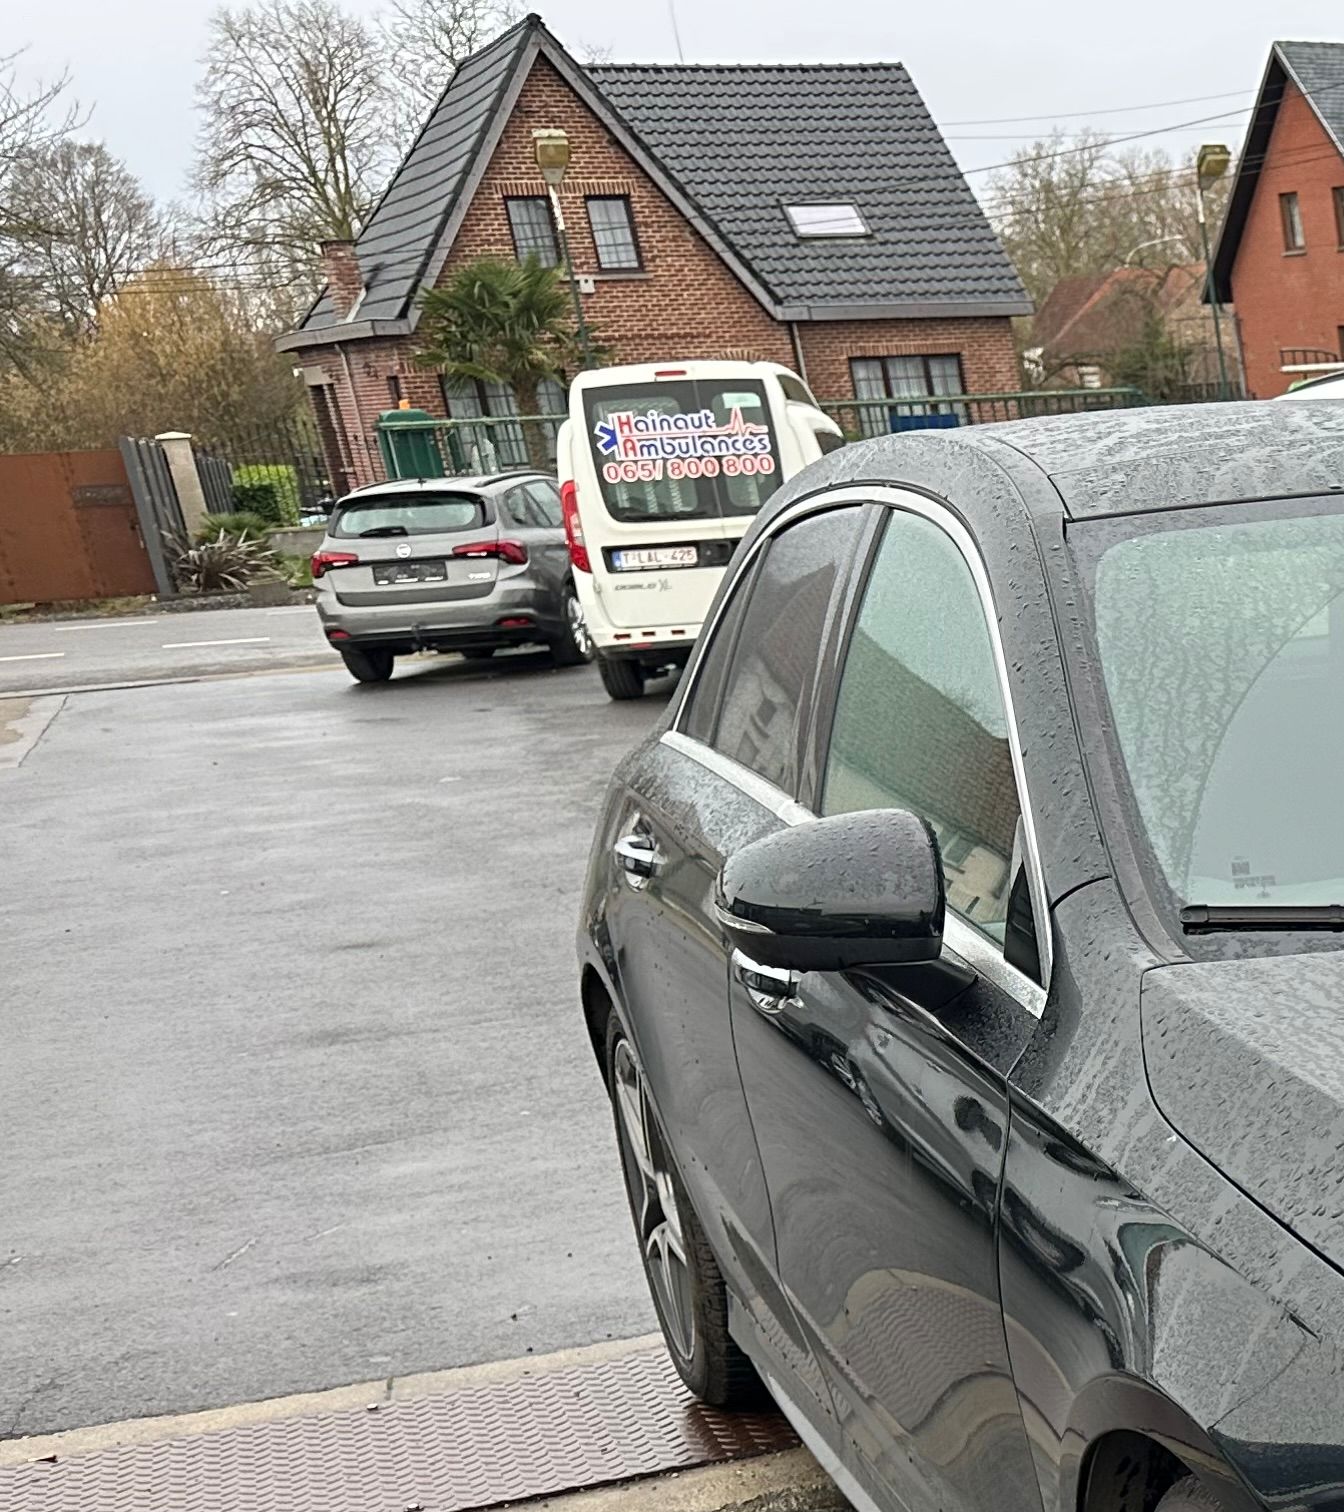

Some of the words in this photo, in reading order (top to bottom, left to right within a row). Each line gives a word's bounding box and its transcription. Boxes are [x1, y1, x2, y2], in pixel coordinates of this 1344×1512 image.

[617, 411, 715, 434] Hainaut
[622, 436, 768, 458] Ambulances
[606, 460, 662, 481] 065/
[671, 458, 717, 476] 800
[725, 456, 771, 474] 800
